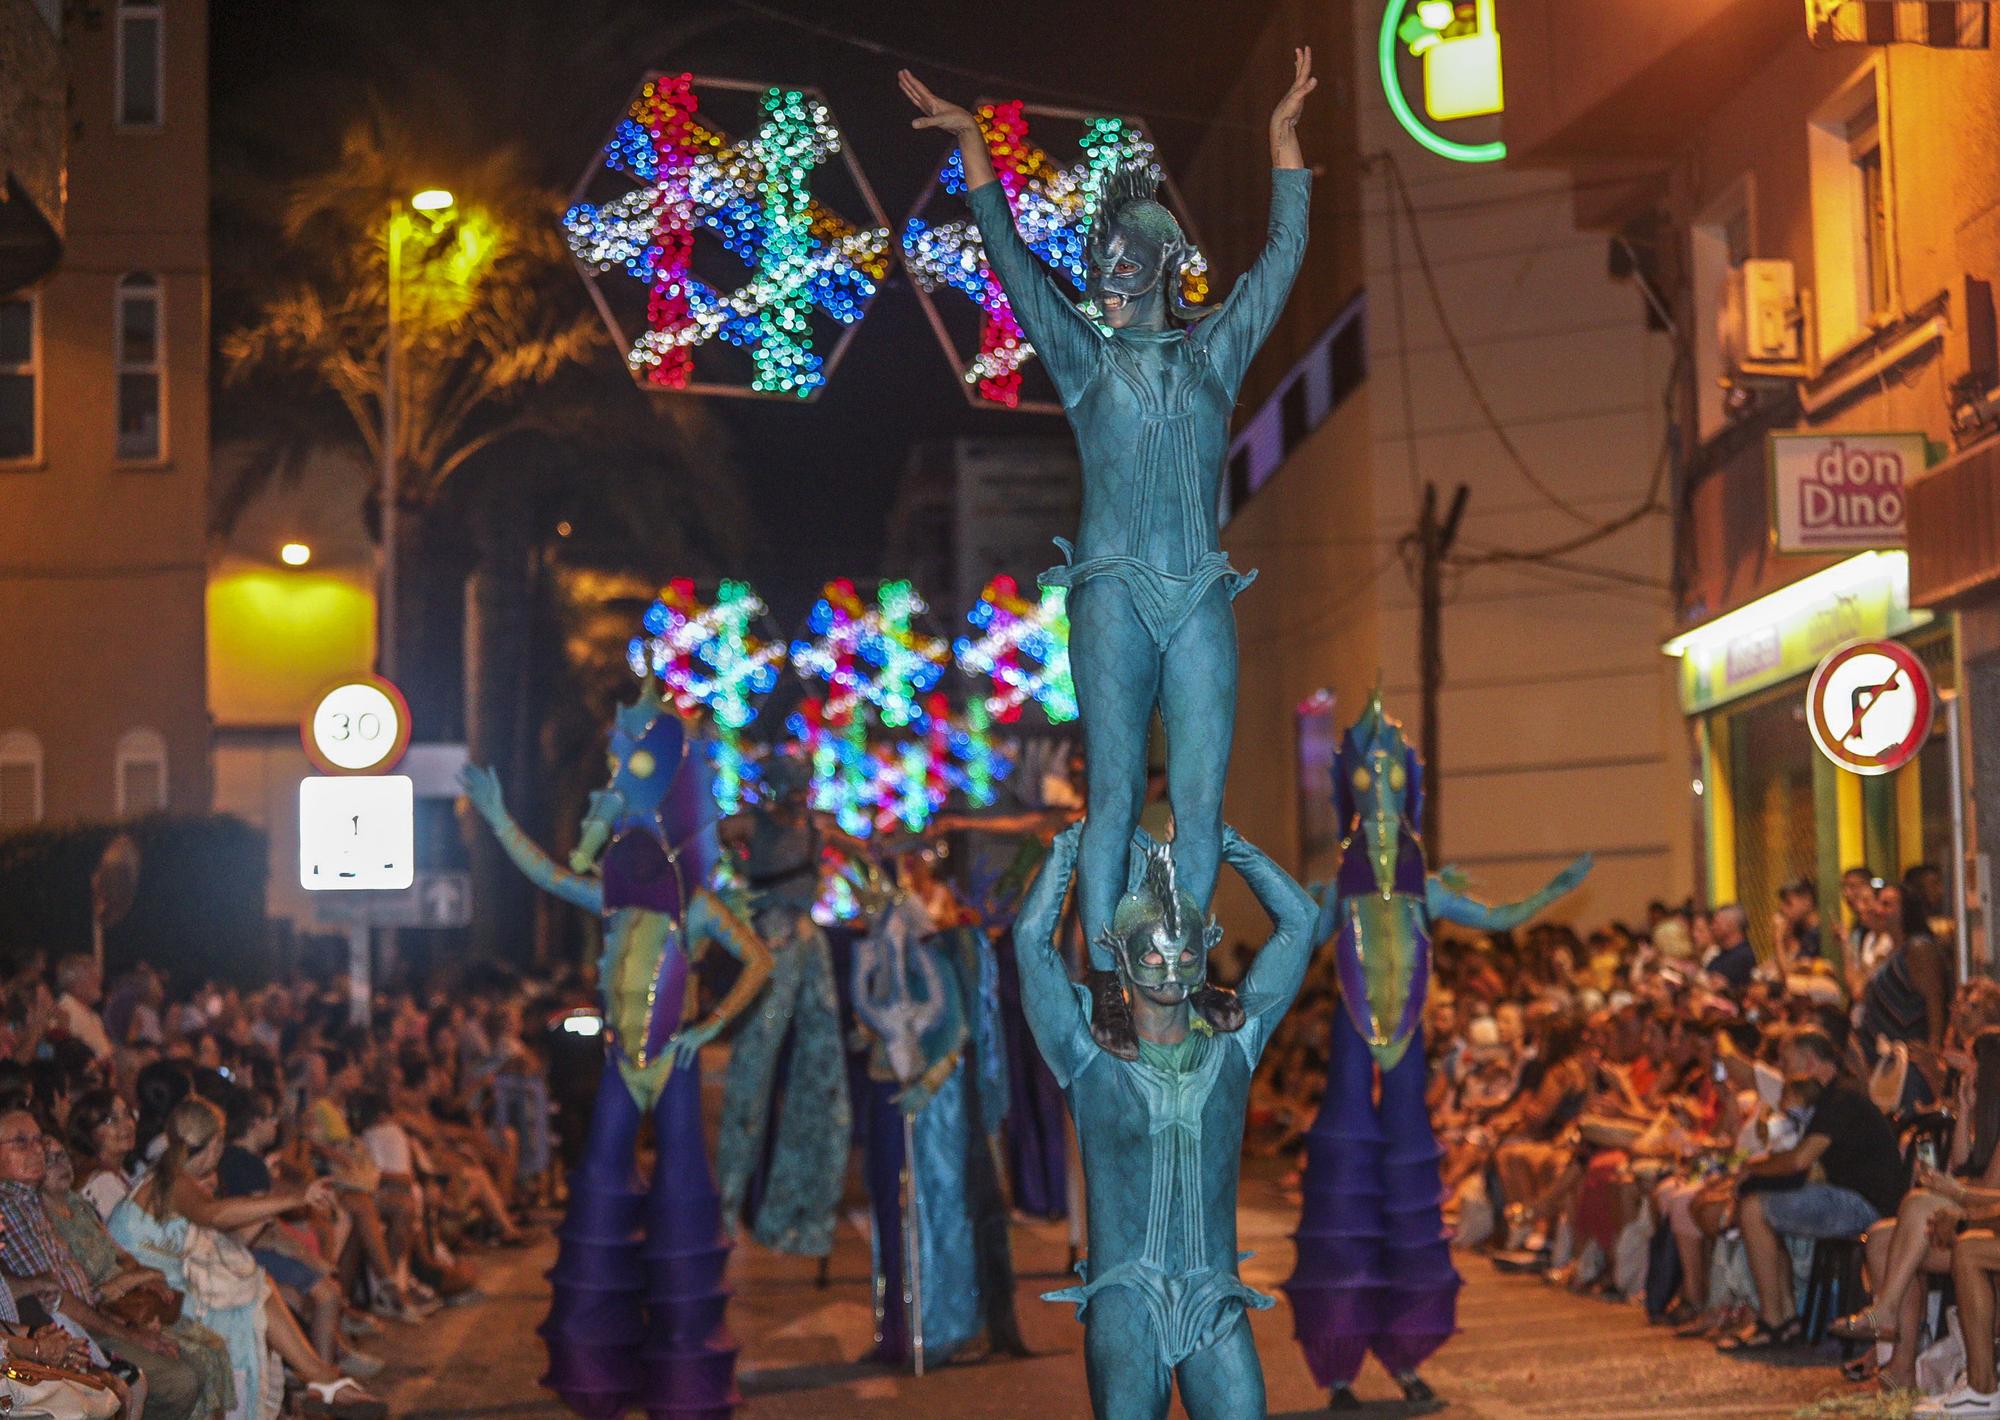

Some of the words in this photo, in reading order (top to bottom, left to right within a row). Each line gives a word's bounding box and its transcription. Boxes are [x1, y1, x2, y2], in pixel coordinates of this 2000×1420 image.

[1819, 443, 1901, 488] don
[1802, 483, 1902, 526] Dino
[330, 712, 381, 741] 30
